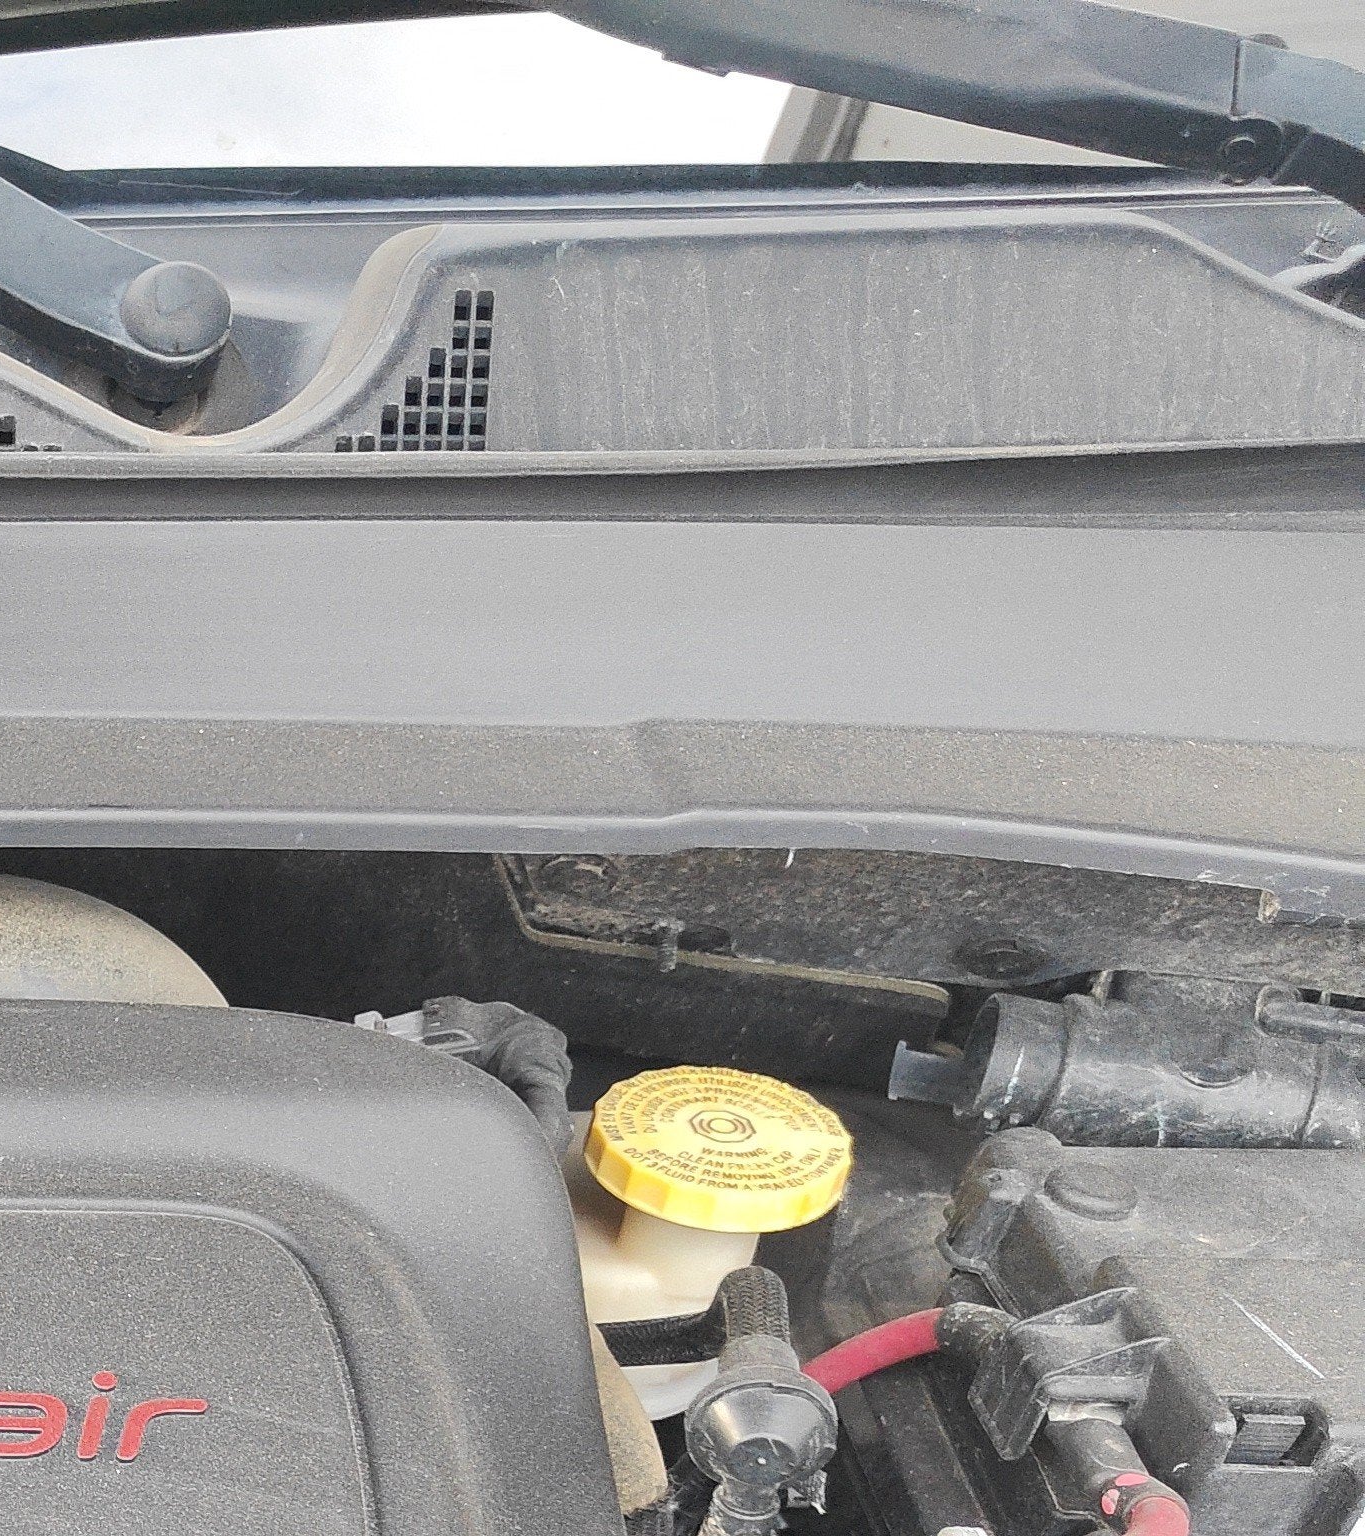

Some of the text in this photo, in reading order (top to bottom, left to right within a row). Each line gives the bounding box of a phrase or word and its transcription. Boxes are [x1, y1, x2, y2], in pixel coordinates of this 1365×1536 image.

[623, 1147, 651, 1162] DOT
[656, 1165, 695, 1182] FLUID
[697, 1178, 738, 1189] FROM
[647, 1149, 699, 1173] BEFORE
[678, 1151, 725, 1169] CLEAN
[772, 1151, 794, 1164] CAP
